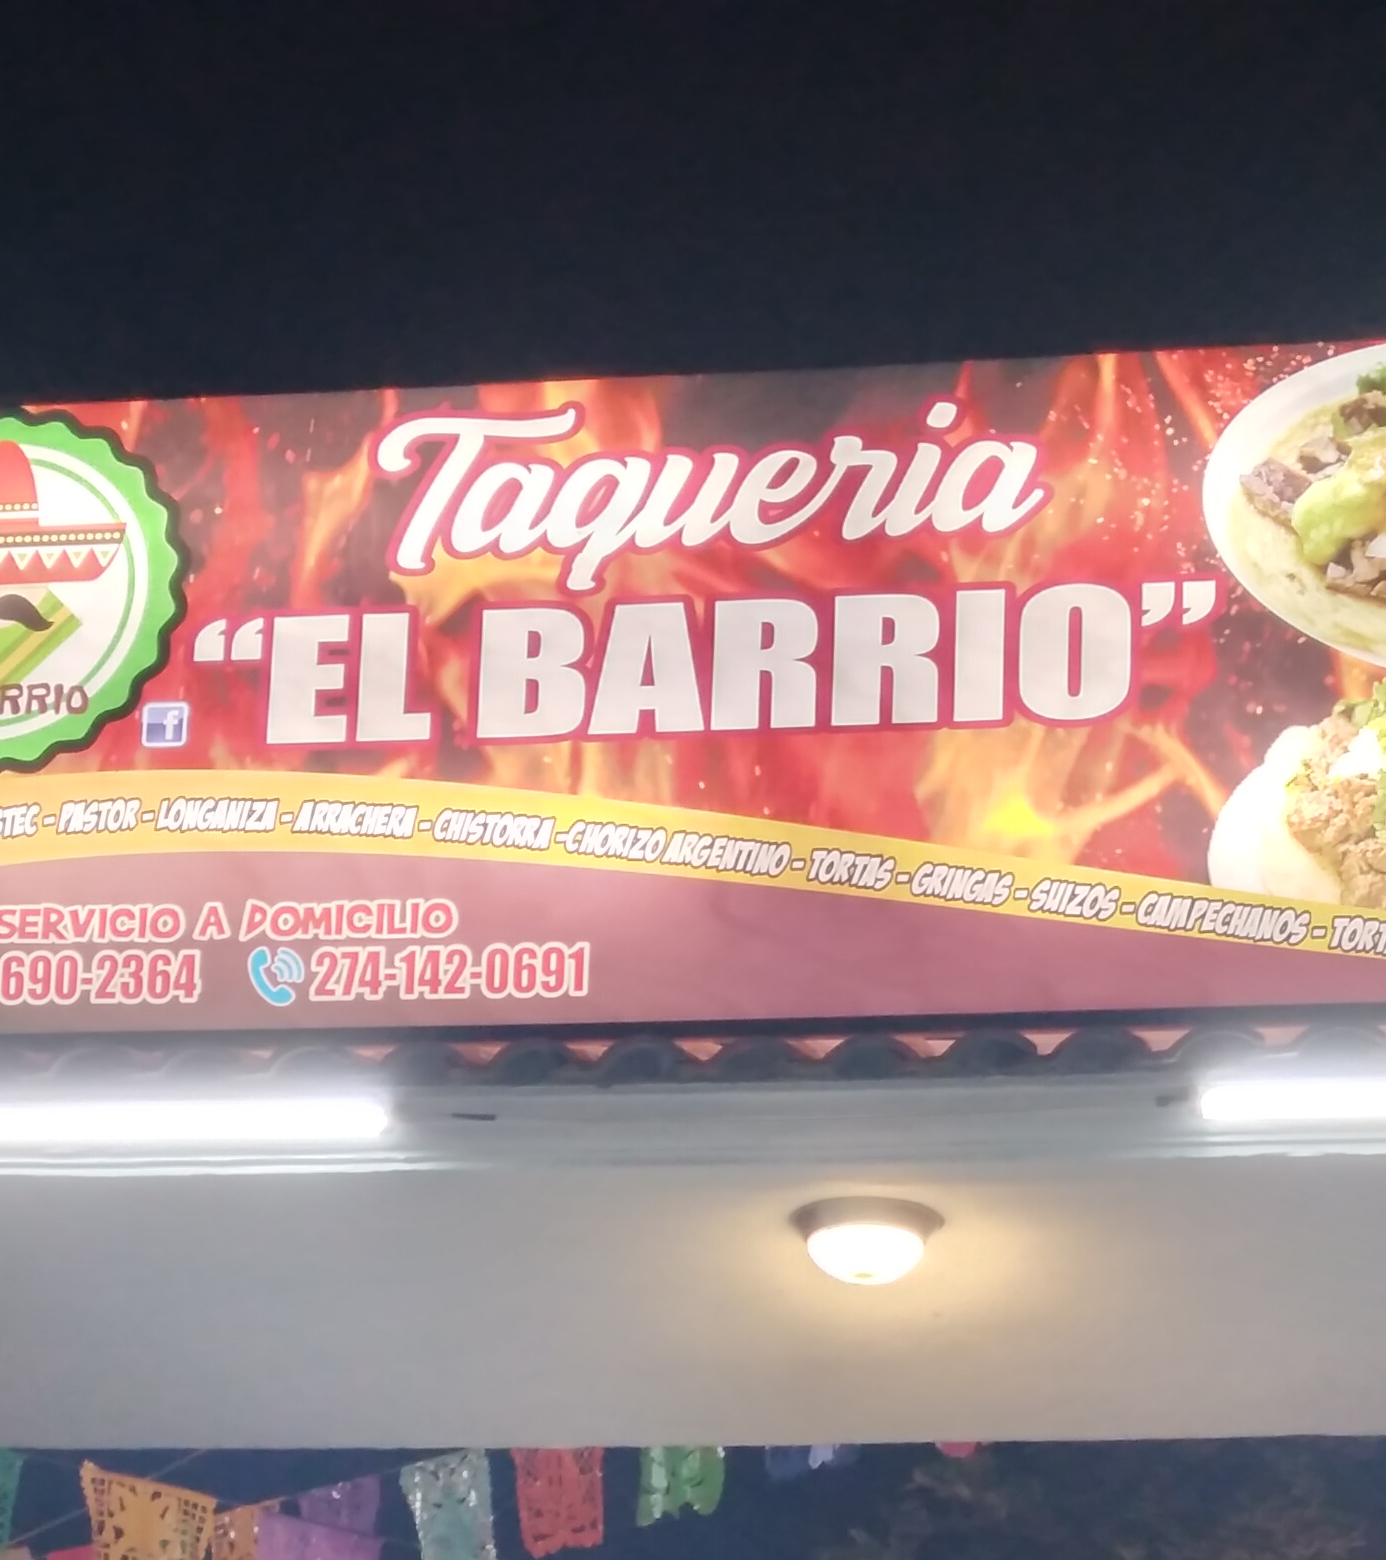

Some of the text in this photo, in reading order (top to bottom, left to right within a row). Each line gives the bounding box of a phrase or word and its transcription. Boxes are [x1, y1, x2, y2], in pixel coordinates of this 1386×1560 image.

[376, 400, 1047, 592] Taqueria
[56, 797, 142, 835] PASTOR
[154, 796, 281, 834] LONGANIZA
[292, 799, 419, 839] ARRACHERA
[432, 808, 556, 850] CHISTORRA
[662, 829, 792, 878] ARGENTINO
[806, 847, 895, 892] TORTAS
[909, 863, 1016, 908] GRINGAS
[1029, 877, 1121, 920] SUIZOS
[1136, 892, 1313, 946] CAMPECHANOS
[192, 901, 232, 942] A
[238, 898, 459, 943] DOMICILIO
[309, 941, 592, 1002] 274-142-0691
